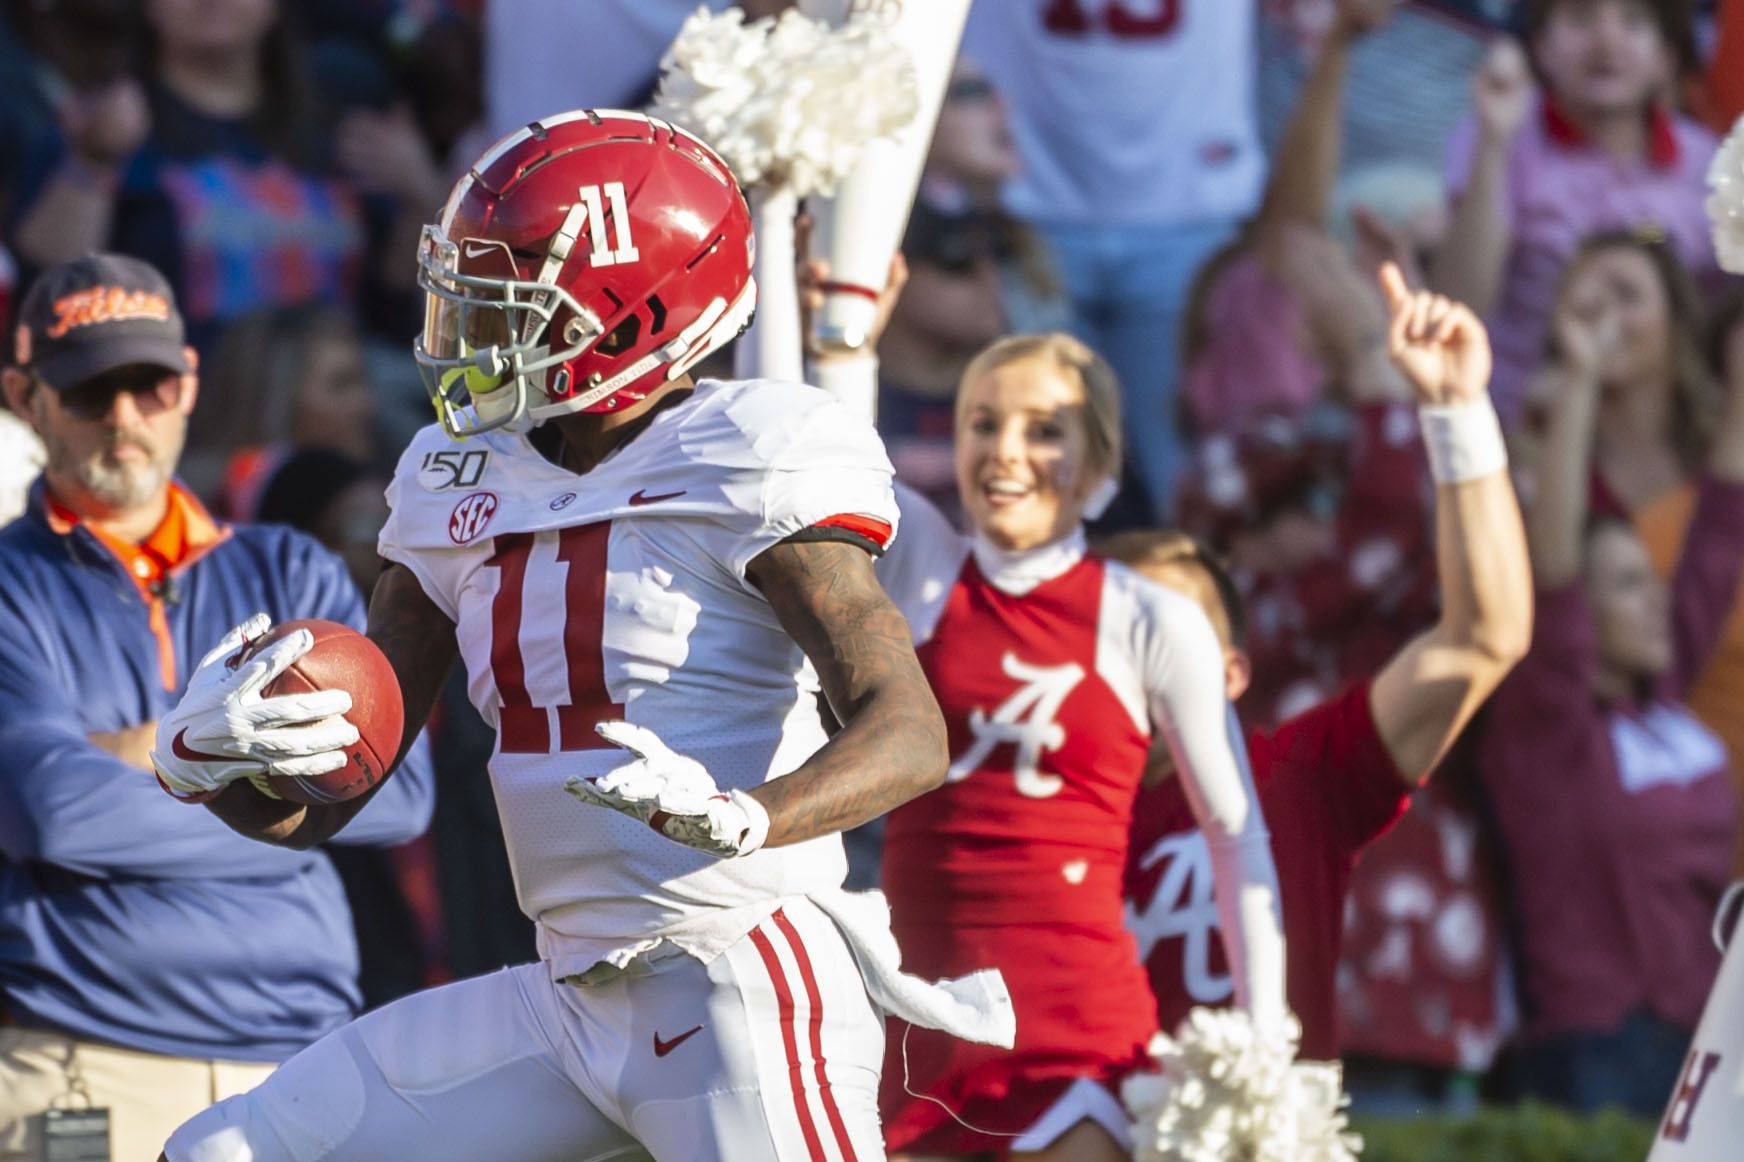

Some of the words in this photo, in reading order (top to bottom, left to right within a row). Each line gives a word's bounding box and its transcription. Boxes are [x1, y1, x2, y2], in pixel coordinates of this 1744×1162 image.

[579, 181, 640, 268] 11
[450, 493, 496, 543] SEC
[484, 519, 626, 755] 11
